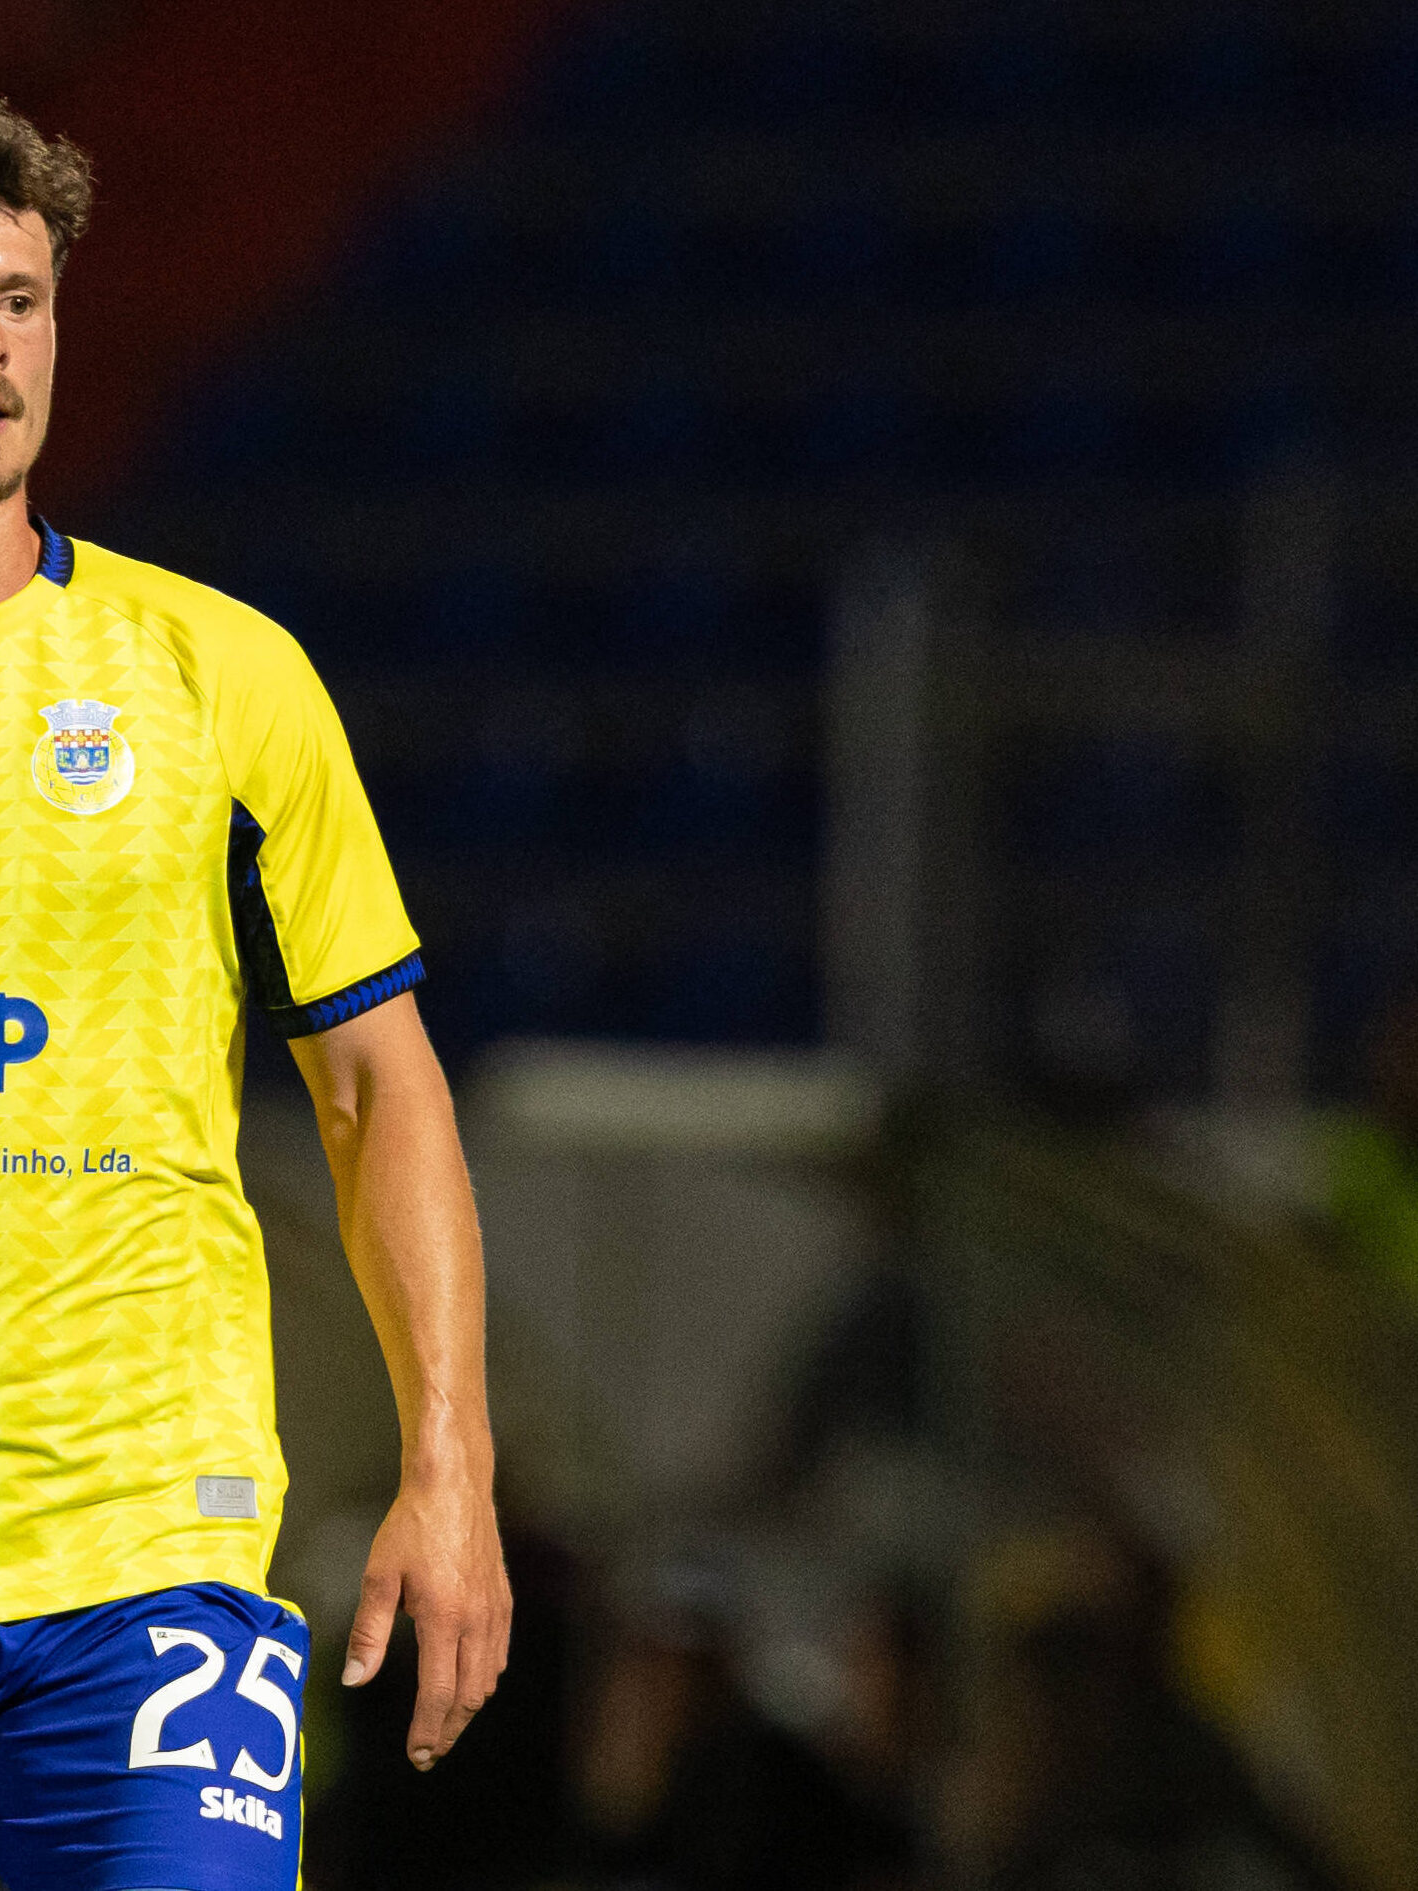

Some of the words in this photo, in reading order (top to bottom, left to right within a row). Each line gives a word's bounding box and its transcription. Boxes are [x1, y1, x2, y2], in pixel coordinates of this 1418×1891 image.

[83, 1148, 139, 1173] Lda.
[128, 1626, 303, 1792] 25
[199, 1786, 283, 1840] Skita
